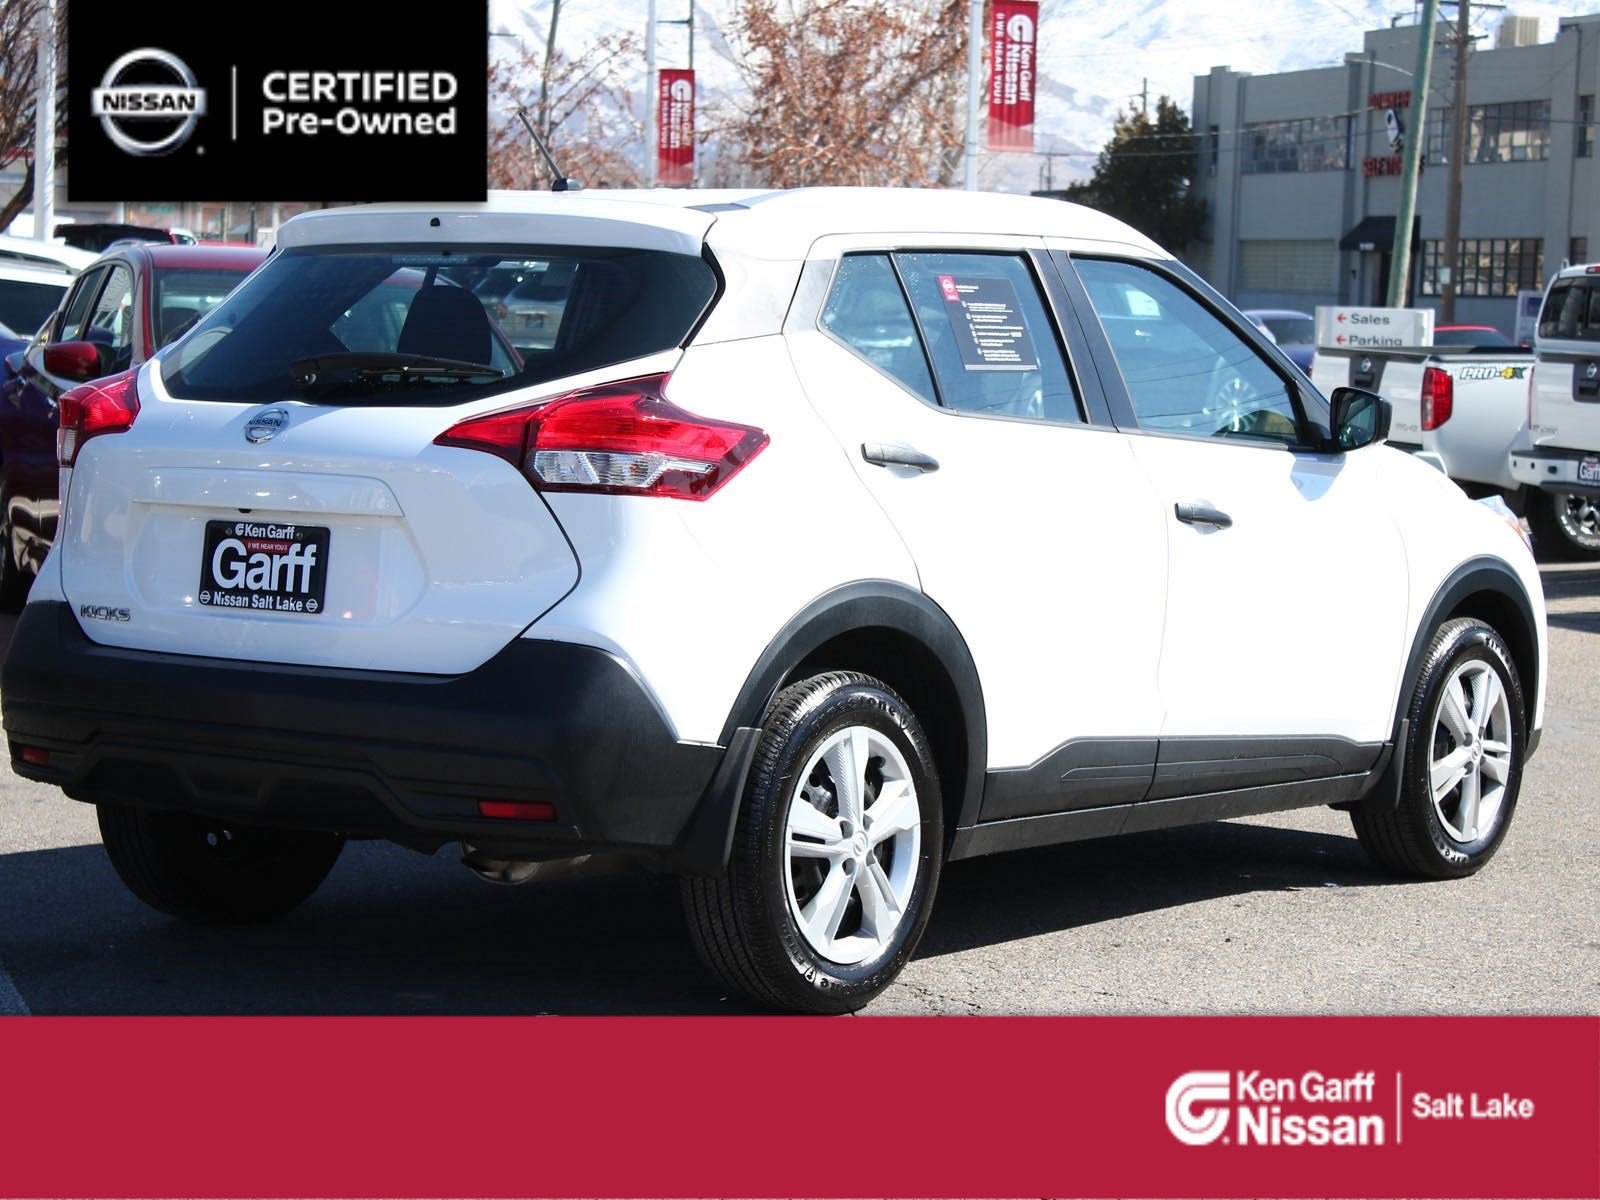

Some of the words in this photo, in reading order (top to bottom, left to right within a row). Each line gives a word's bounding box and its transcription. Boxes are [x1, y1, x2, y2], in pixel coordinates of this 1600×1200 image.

[1021, 43, 1033, 69] Ken
[1005, 43, 1020, 105] Nissan
[1019, 70, 1032, 102] Garff
[1351, 313, 1390, 325] Sales
[1460, 367, 1527, 380] PRO-4X
[244, 523, 266, 538] Ken
[267, 525, 295, 540] Garff
[251, 542, 260, 550] WE
[274, 543, 285, 551] YOU
[212, 538, 317, 593] Garff
[213, 591, 249, 607] Nissan
[251, 594, 273, 609] Salt
[276, 597, 303, 611] Lake
[80, 604, 131, 621] KICKS
